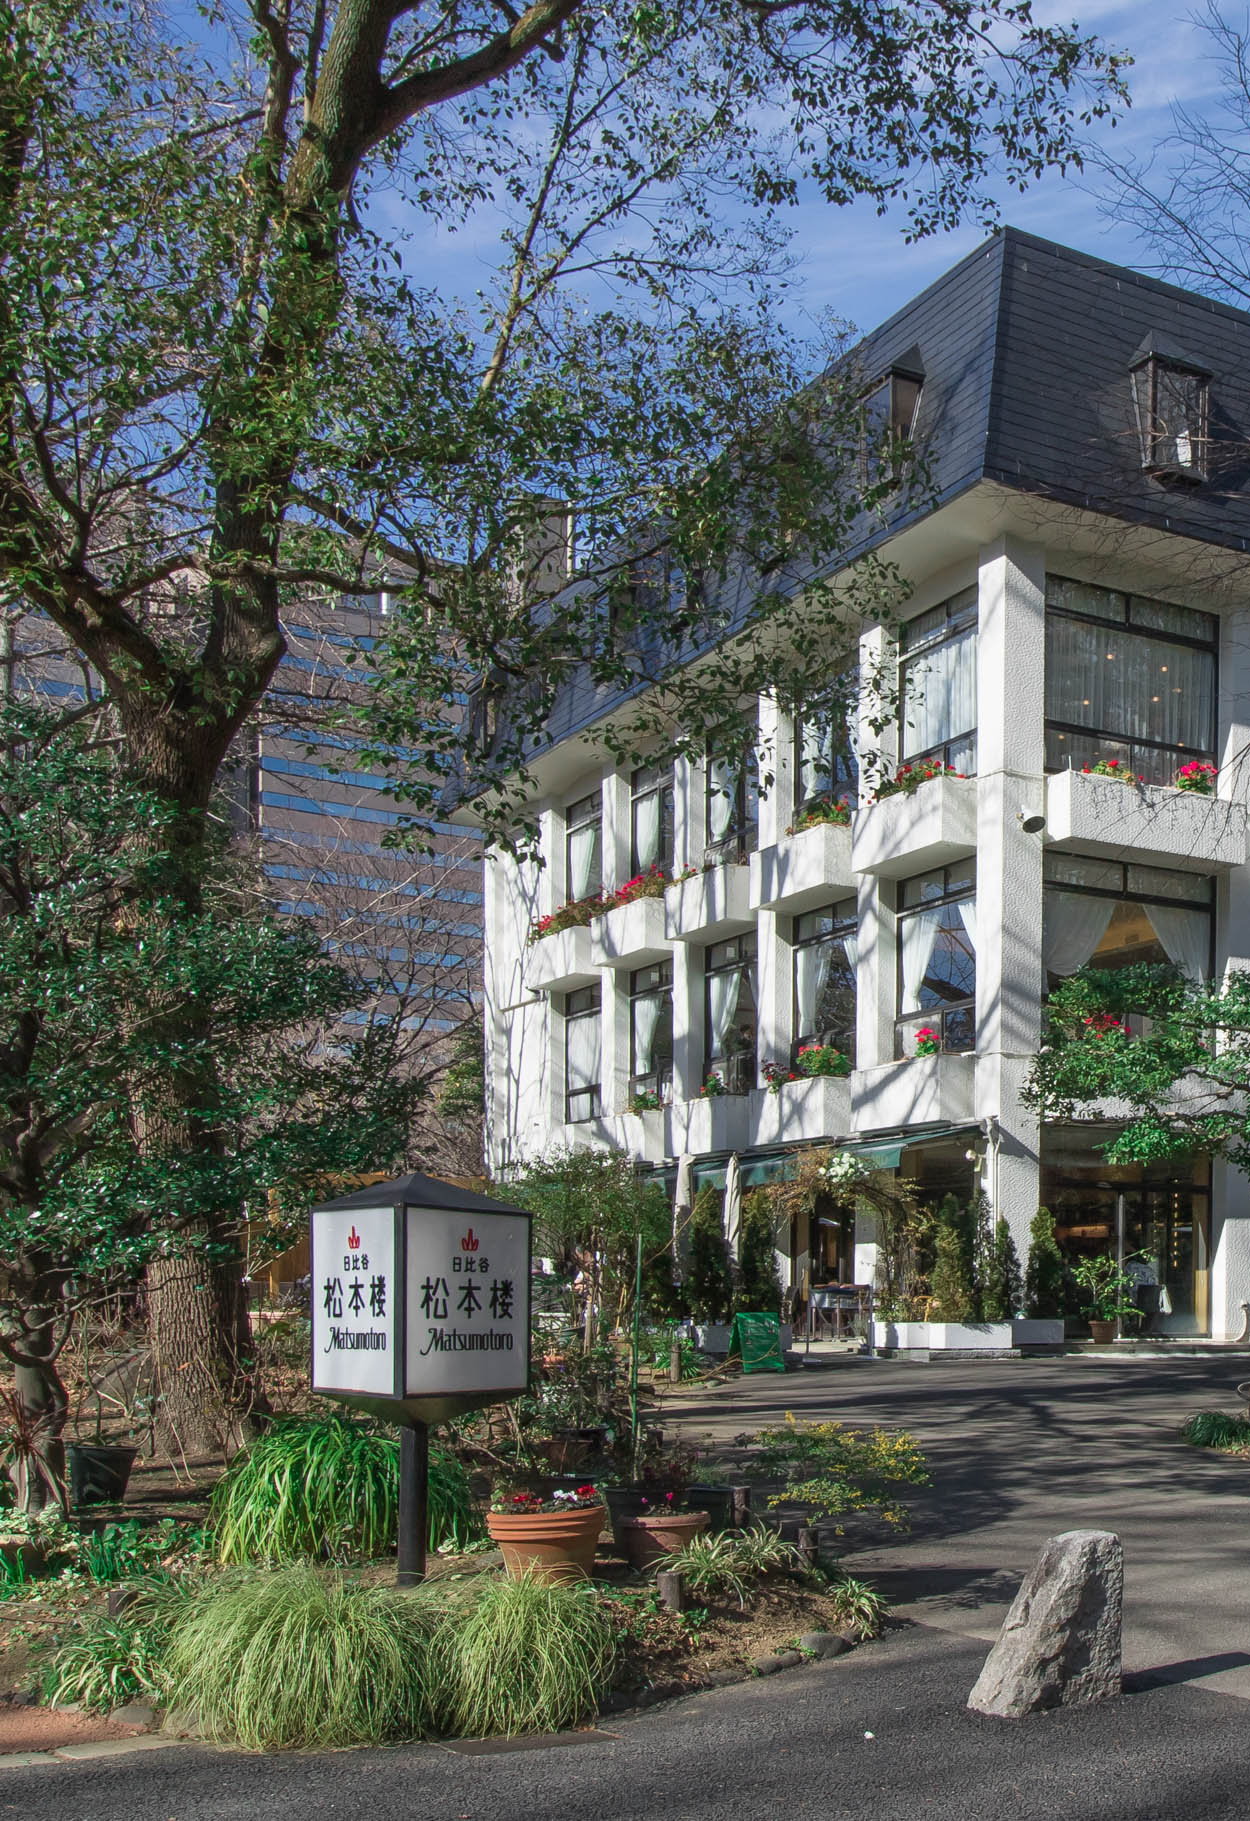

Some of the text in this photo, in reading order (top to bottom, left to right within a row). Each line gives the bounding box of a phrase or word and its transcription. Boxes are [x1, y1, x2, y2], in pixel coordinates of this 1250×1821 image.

[344, 1254, 370, 1271] 日比谷
[452, 1256, 490, 1273] 日比谷
[324, 1275, 386, 1318] 松本楼
[420, 1276, 514, 1320] 松本楼
[324, 1327, 387, 1353] Matsumotoro
[420, 1327, 514, 1356] Matsumotoro
